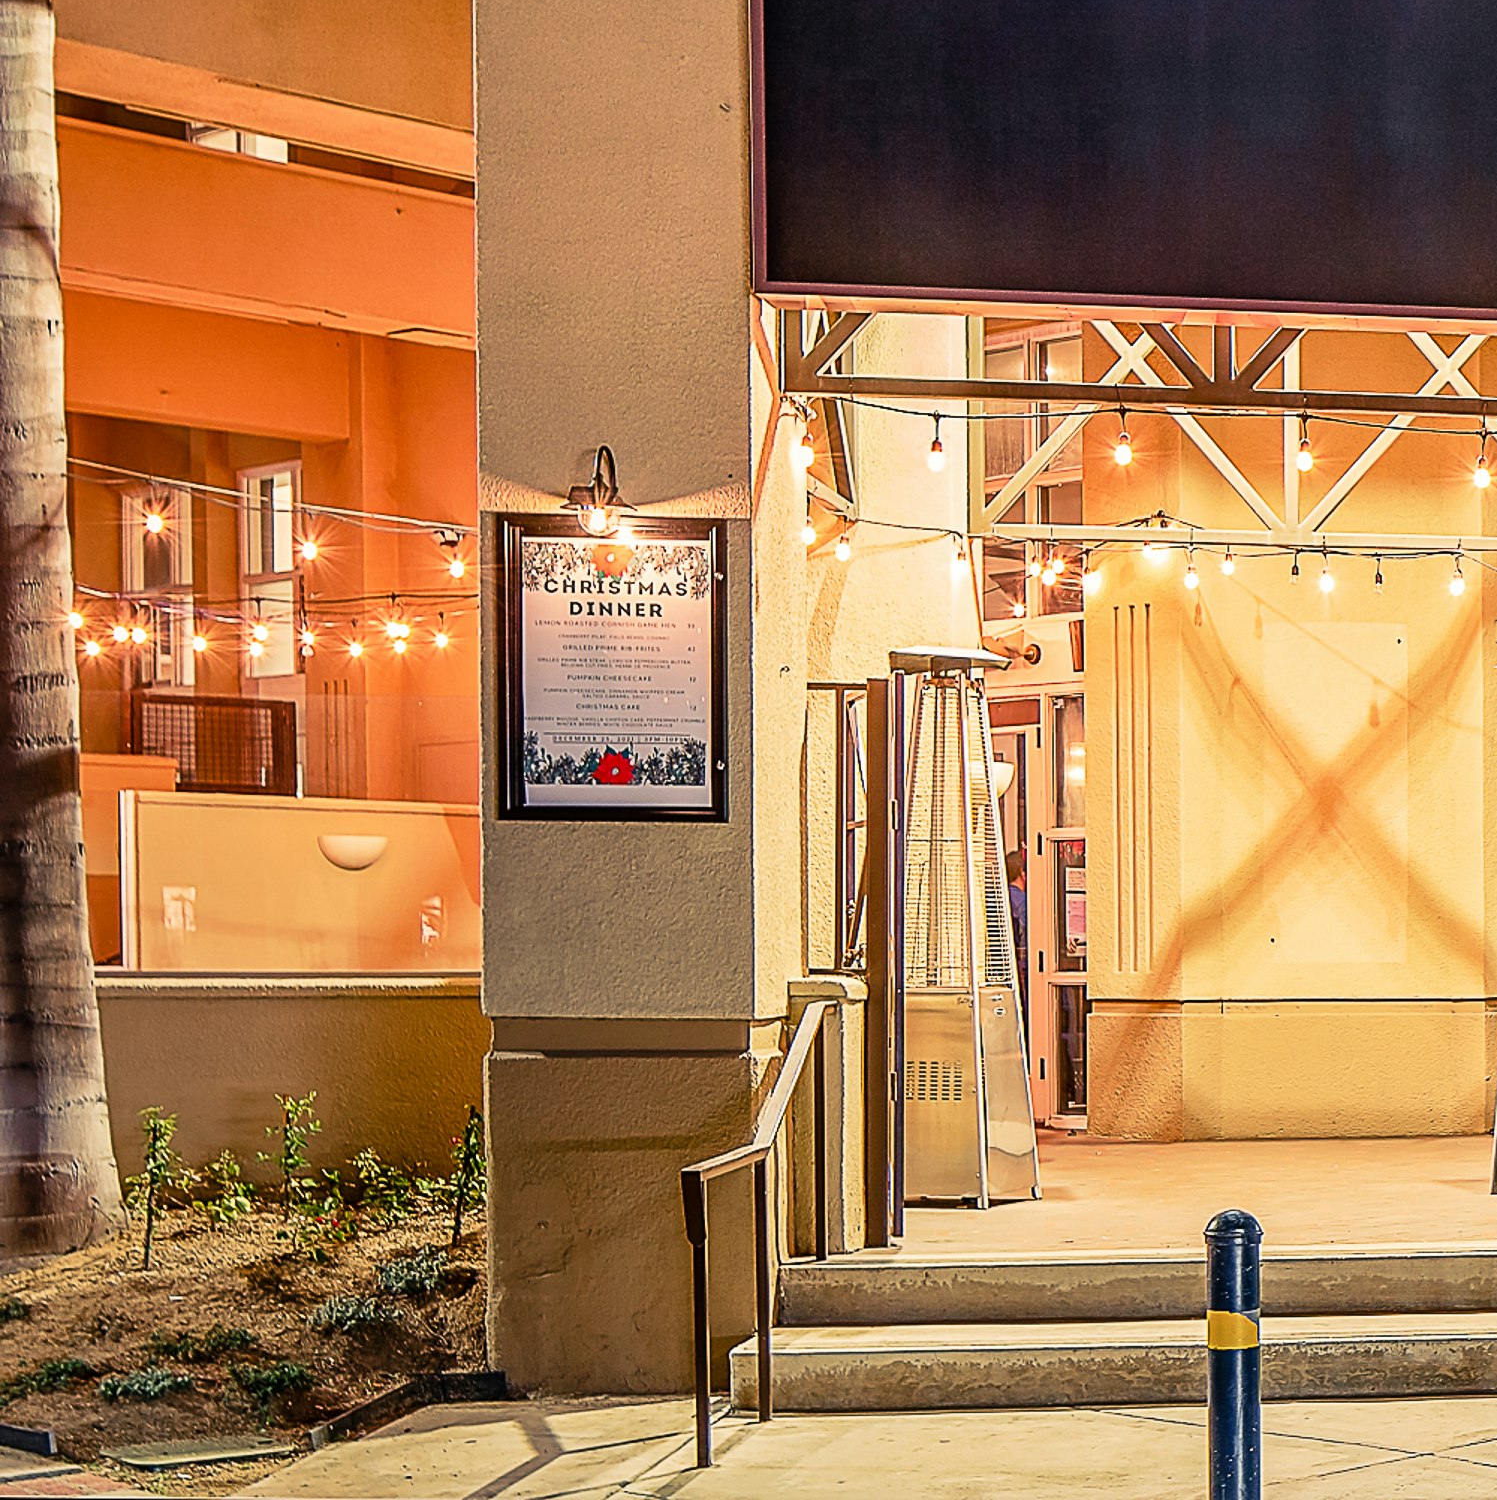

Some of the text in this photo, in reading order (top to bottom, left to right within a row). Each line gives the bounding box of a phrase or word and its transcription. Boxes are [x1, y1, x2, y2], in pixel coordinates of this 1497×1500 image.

[544, 579, 688, 597] CHRISTMAS
[569, 601, 663, 618] DINNER
[564, 620, 599, 628] ROASTED
[567, 674, 601, 682] PUMPKIN
